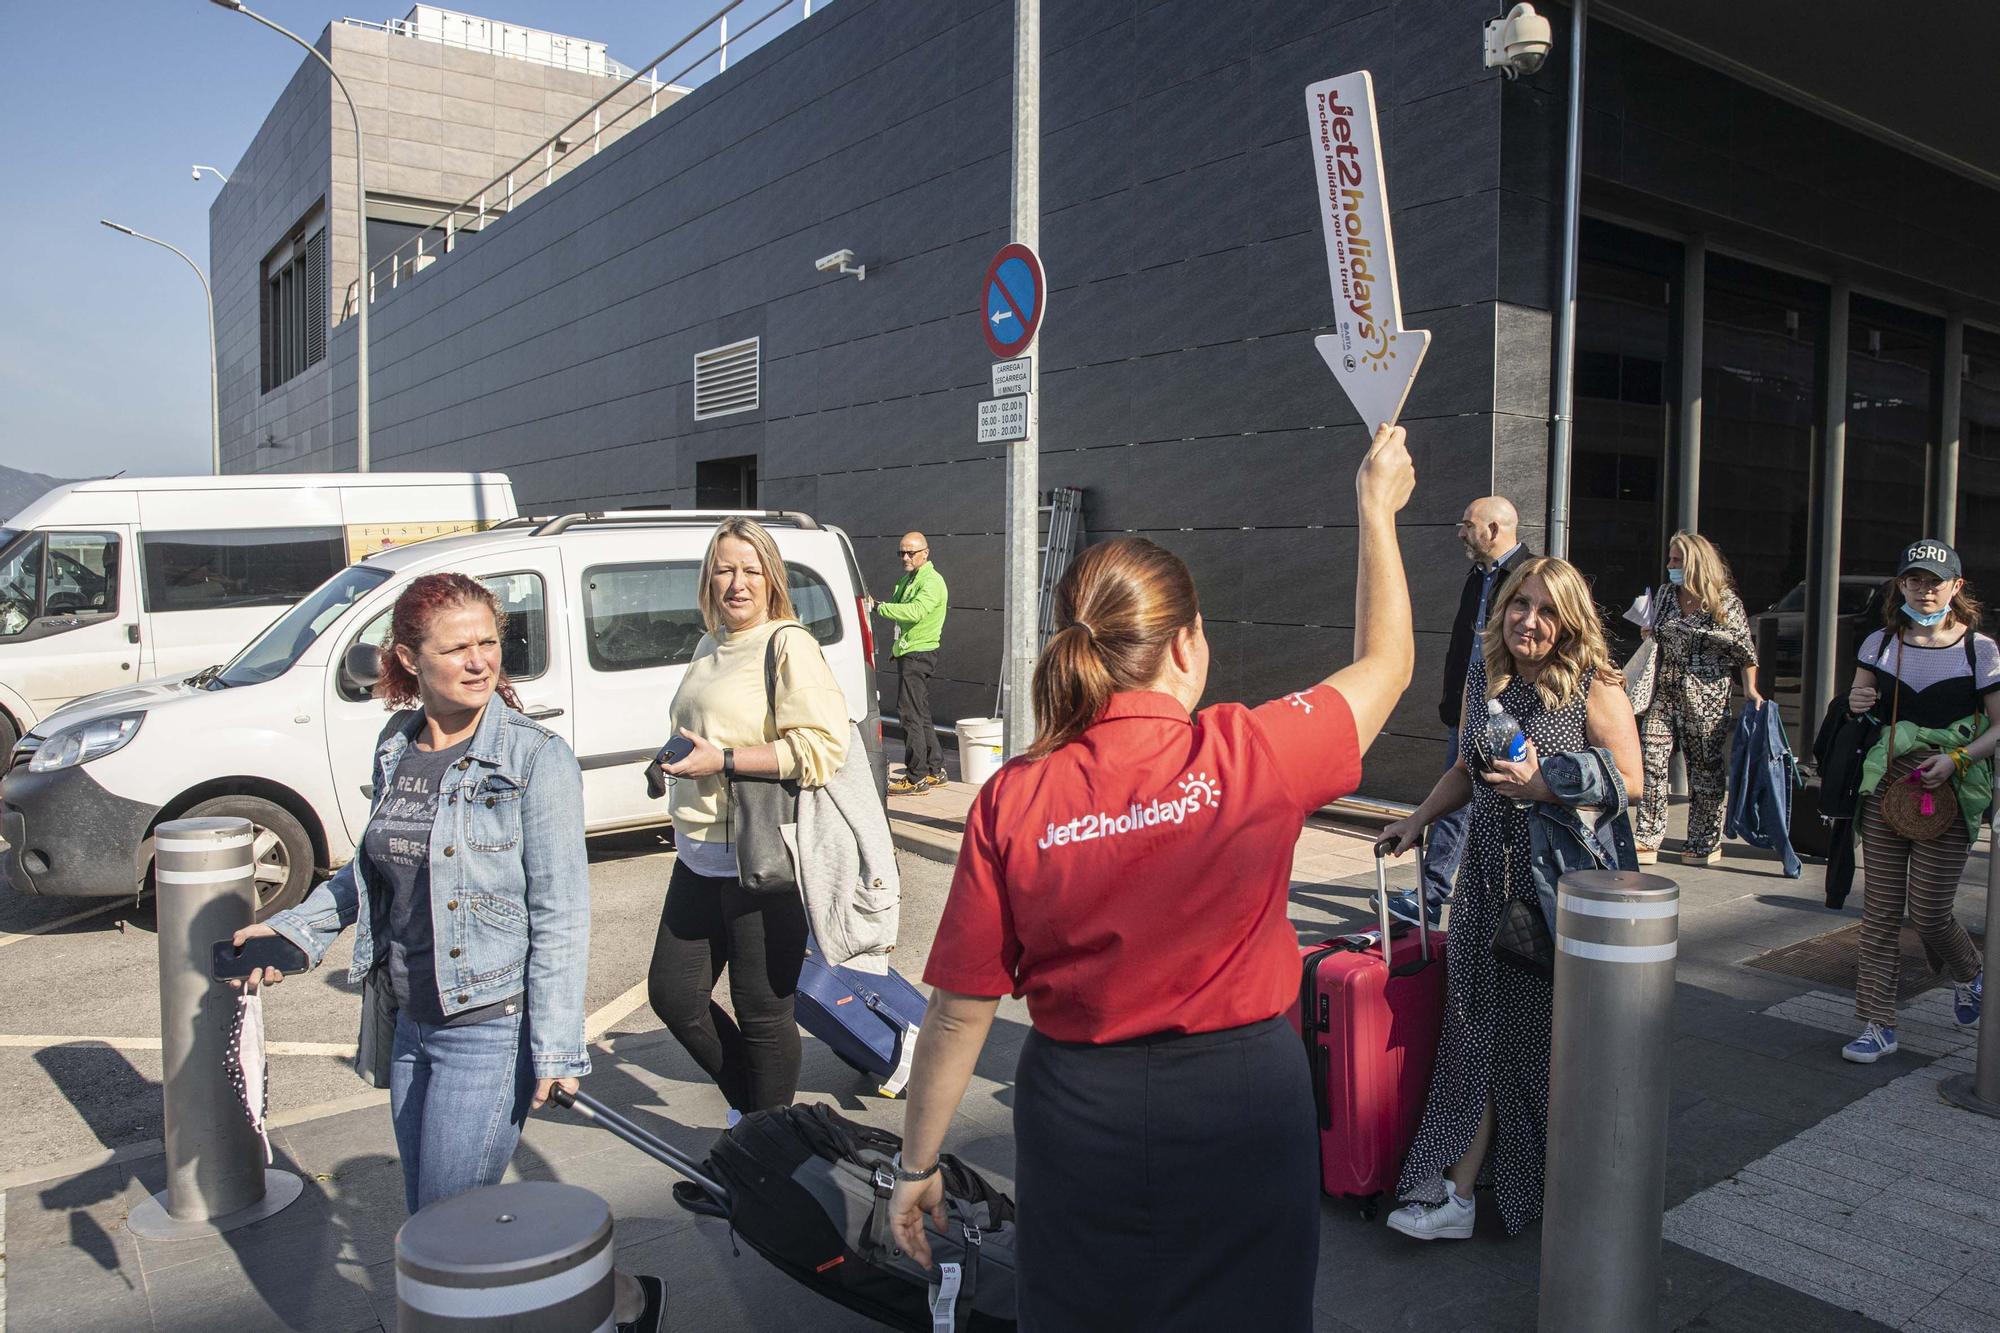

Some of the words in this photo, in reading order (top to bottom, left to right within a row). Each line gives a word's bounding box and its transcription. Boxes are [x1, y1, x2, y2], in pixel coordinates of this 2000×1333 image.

[1317, 93, 1331, 152] Package
[1325, 155, 1338, 210] holidays
[1328, 90, 1376, 339] Jet2holidays
[1332, 214, 1342, 237] you
[1337, 241, 1345, 264] can
[1340, 268, 1351, 299] trust
[1003, 384, 1021, 393] MINUTS
[981, 404, 997, 415] 00.00
[1002, 401, 1017, 412] 02.00
[981, 416, 997, 426] 06.00
[1002, 413, 1017, 424] 10.00
[981, 427, 996, 438] 17.00
[1001, 425, 1017, 436] 20.00
[1908, 545, 1947, 563] GSRD
[396, 775, 429, 794] REAL
[1038, 790, 1201, 850] Jet2holidays
